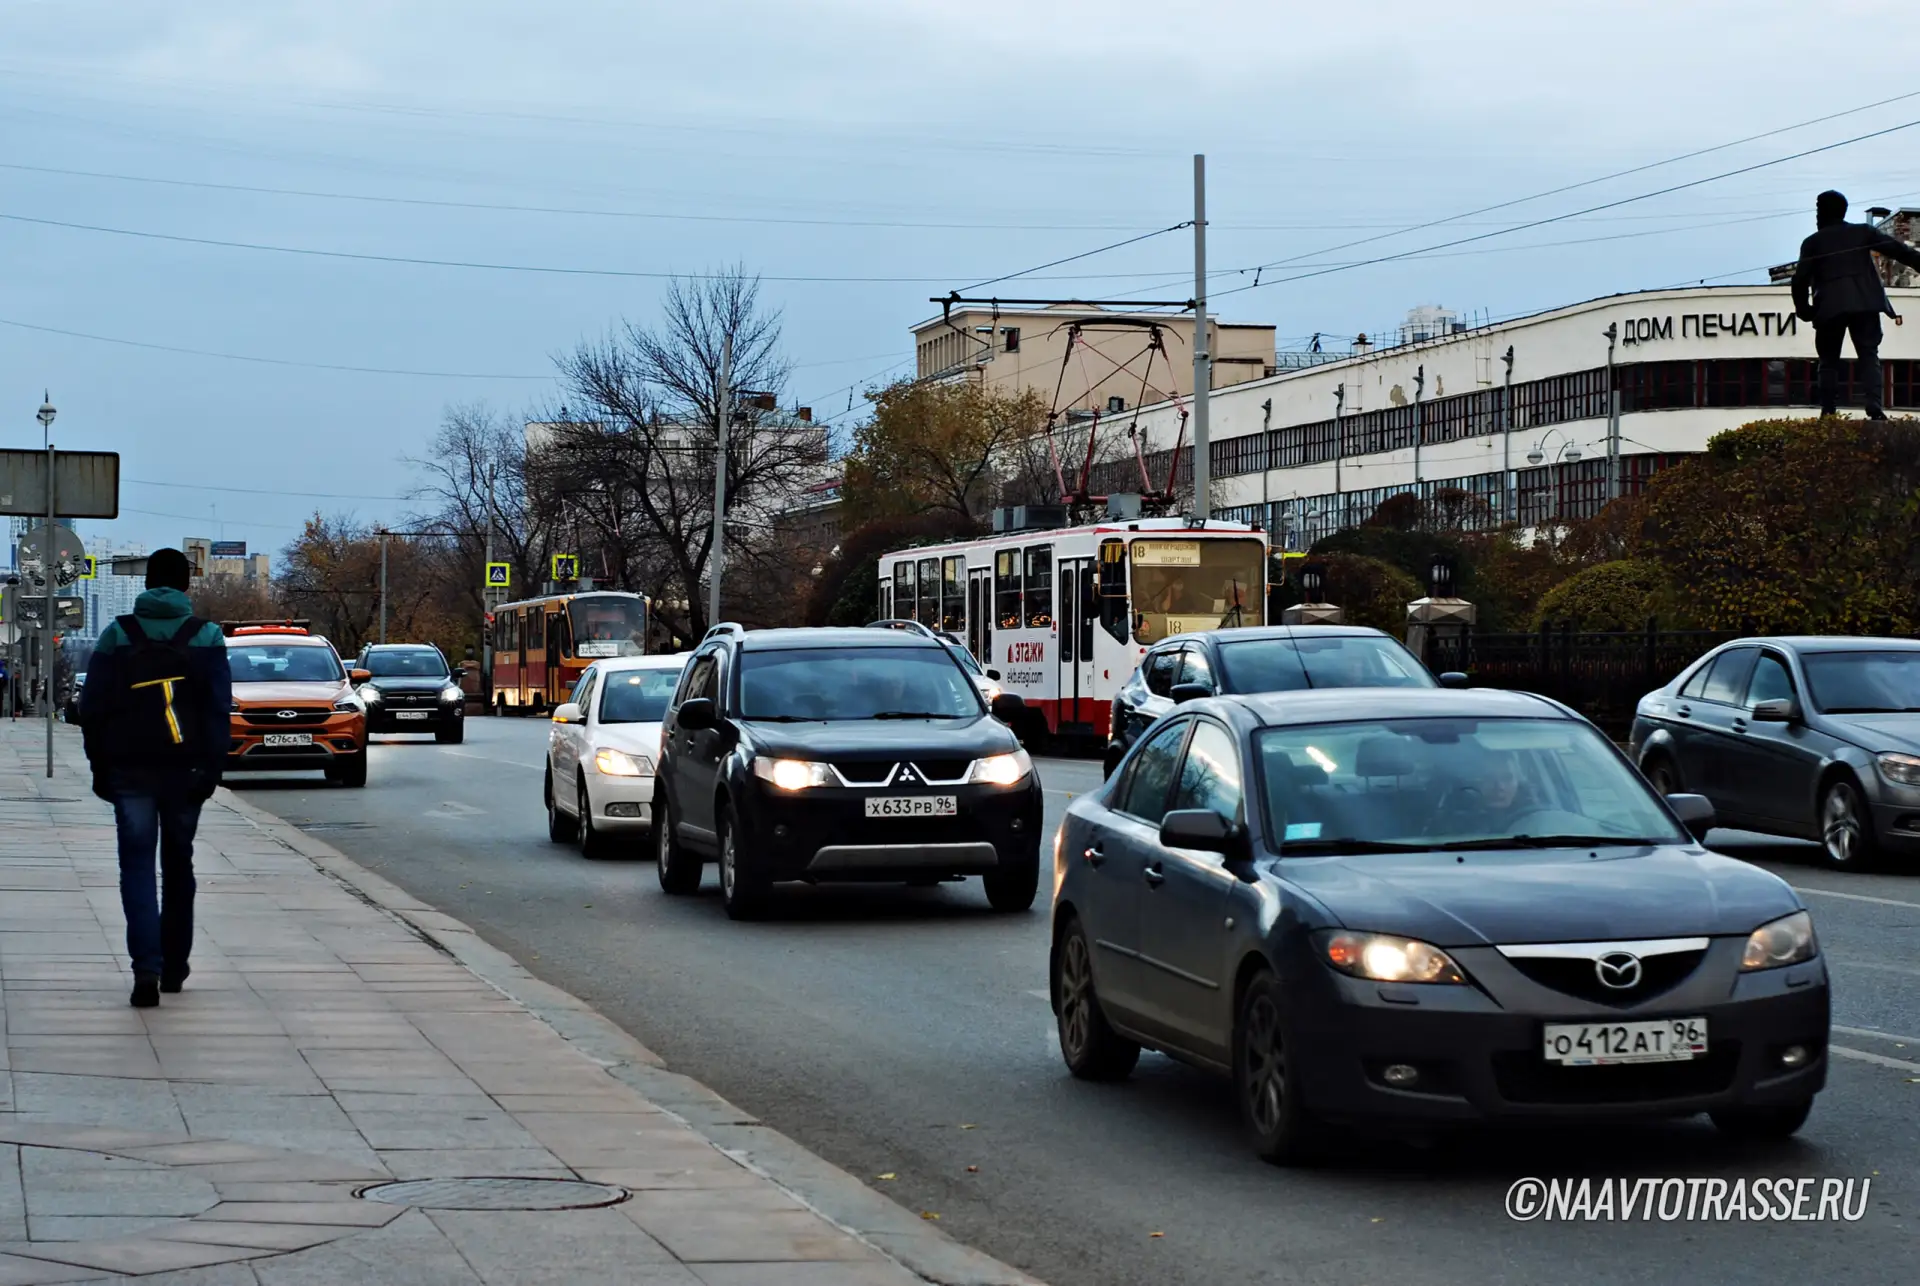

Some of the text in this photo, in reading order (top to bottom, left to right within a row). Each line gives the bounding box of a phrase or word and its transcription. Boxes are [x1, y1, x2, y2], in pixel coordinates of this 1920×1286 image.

[1622, 312, 1798, 347] ДОМ ПЕЧАТИ
[1133, 545, 1146, 558] 18
[1169, 620, 1182, 634] 18
[1007, 666, 1044, 688] ekb.etagi.com
[871, 797, 952, 815] Х633РВ 96
[1554, 1021, 1699, 1055] О412АТ 96
